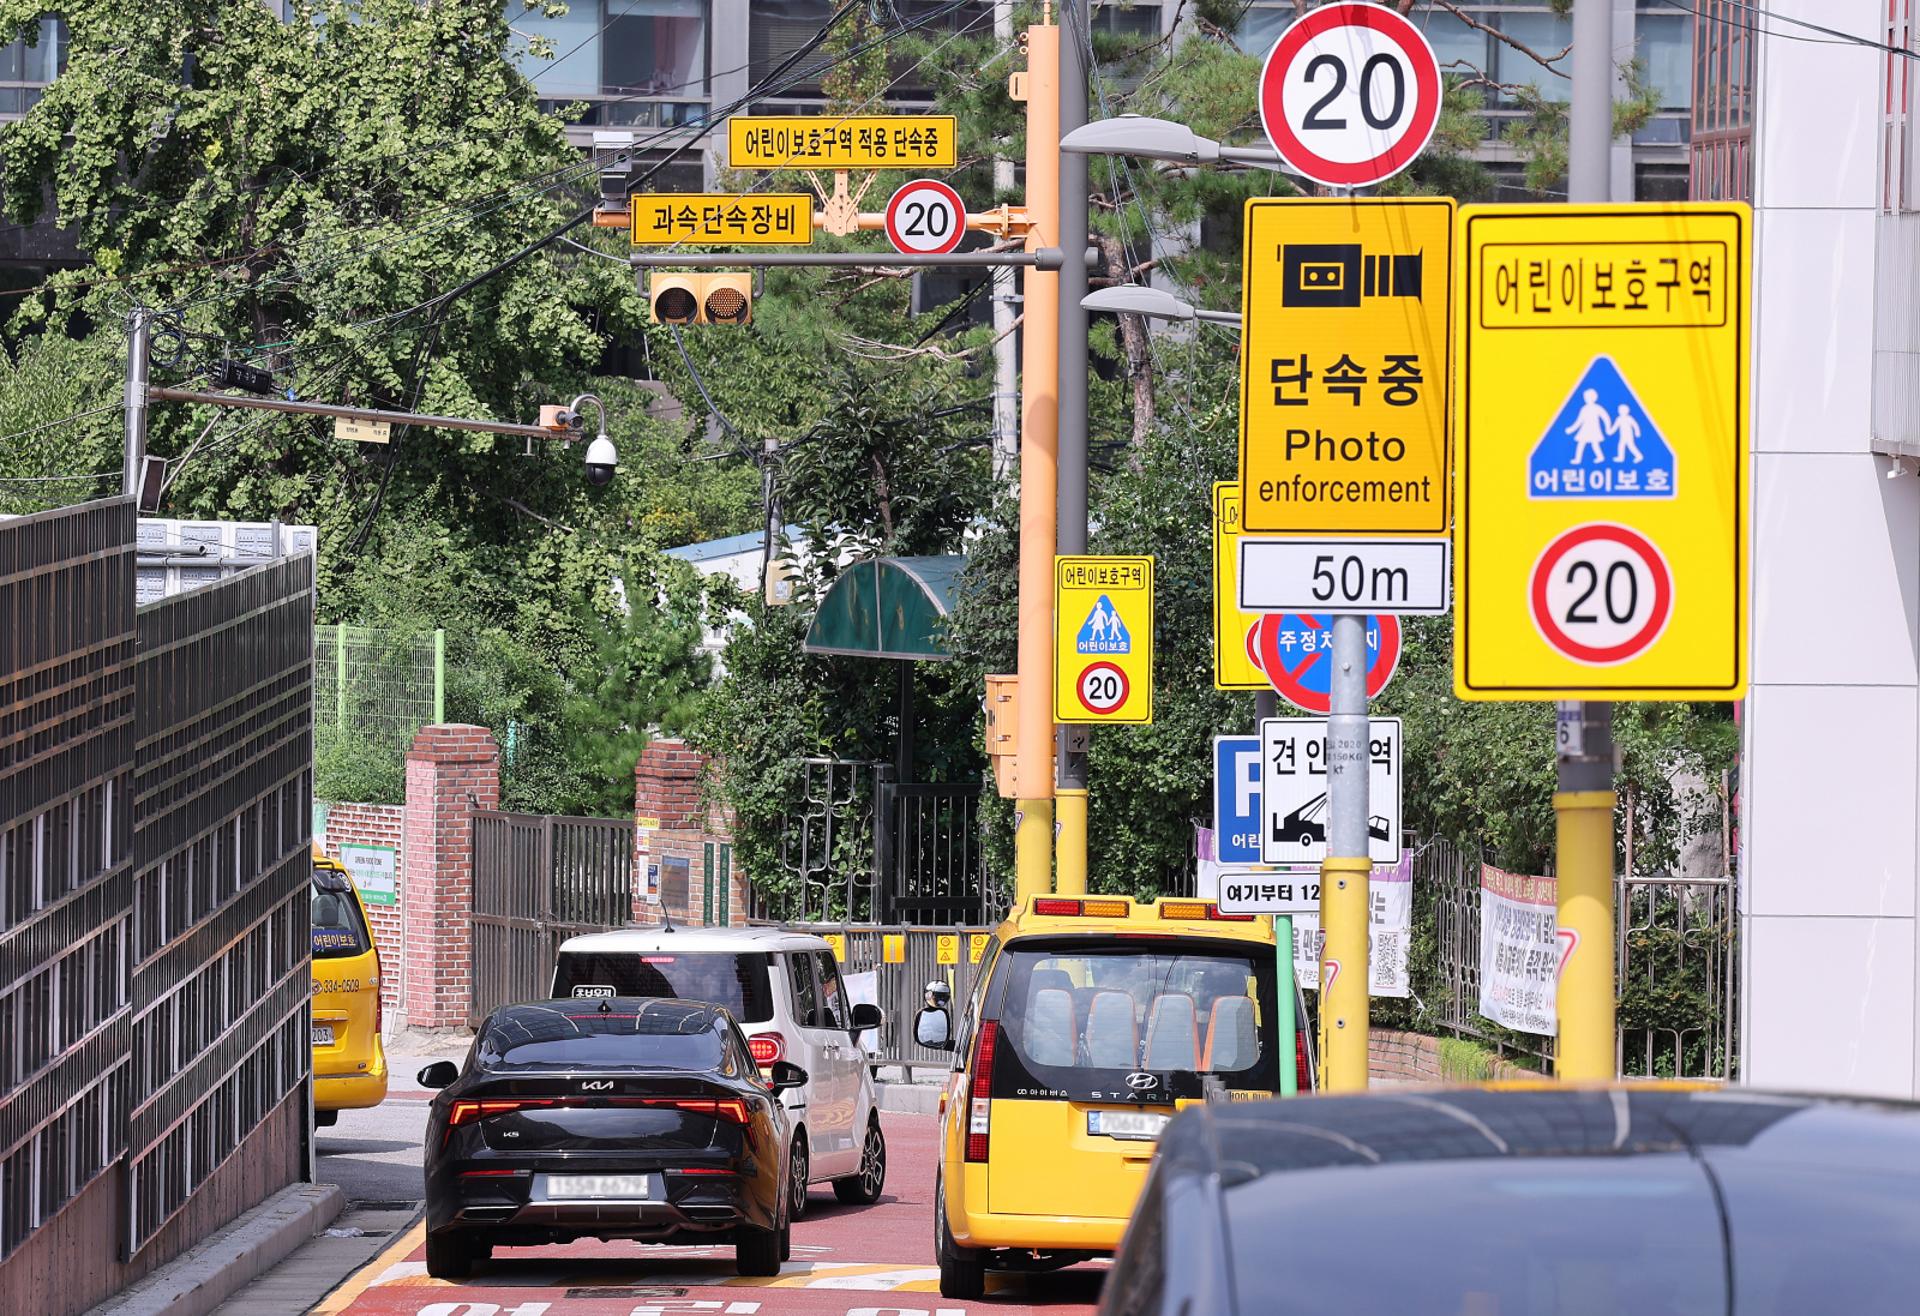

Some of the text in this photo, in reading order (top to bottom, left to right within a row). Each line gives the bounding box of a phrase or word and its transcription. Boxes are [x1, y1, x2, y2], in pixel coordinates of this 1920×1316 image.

[1302, 53, 1406, 130] 20
[745, 127, 939, 158] 어린이보호구역 적용 단속중
[652, 204, 796, 236] 과속단속장비
[904, 202, 949, 237] 20
[1495, 256, 1712, 314] 어린이보호구역
[1270, 353, 1424, 407] 단속중
[1285, 429, 1406, 461] Photo
[1259, 475, 1431, 503] enforcement
[1533, 468, 1672, 493] 어린이보호
[1065, 567, 1141, 586] 어린이보호구역
[1311, 554, 1409, 602] 50m
[1565, 560, 1638, 624] 20
[1078, 641, 1129, 652] 어린이보호
[1280, 629, 1378, 652] 주정차지
[1089, 676, 1117, 700] 20
[1272, 736, 1391, 775] 견인역
[1227, 884, 1293, 902] 여기부터
[313, 934, 357, 948] 어린이보호
